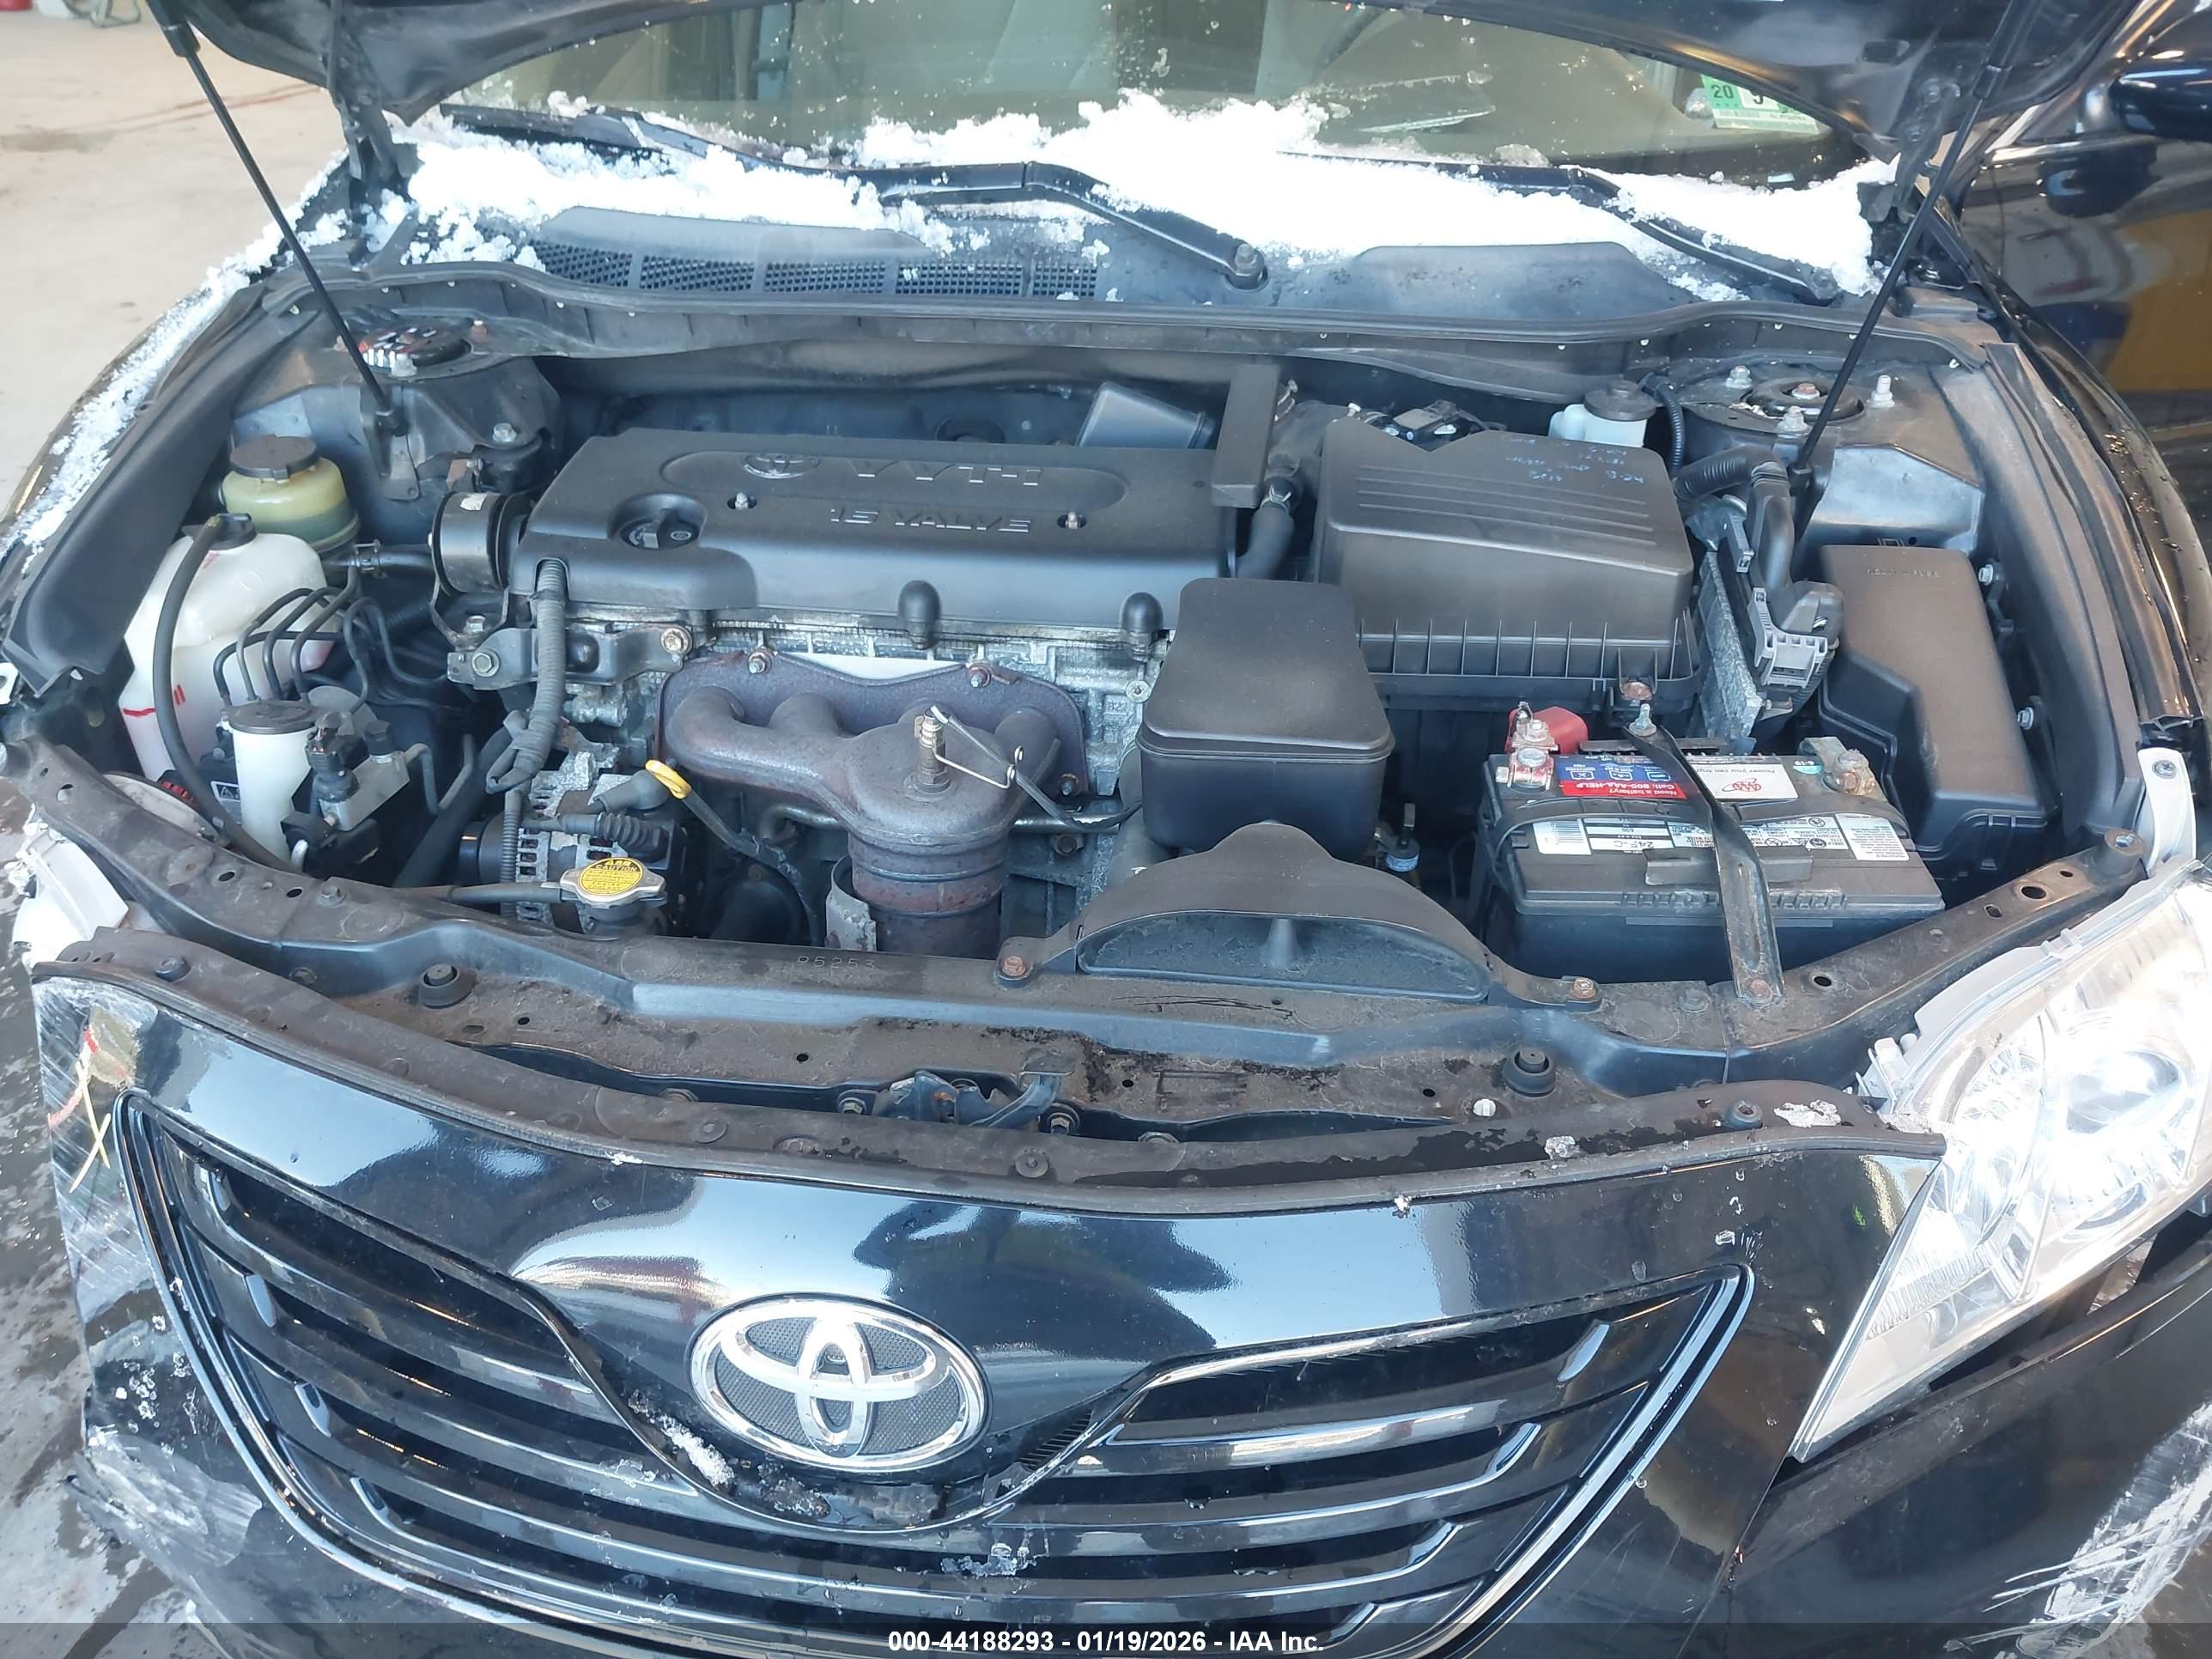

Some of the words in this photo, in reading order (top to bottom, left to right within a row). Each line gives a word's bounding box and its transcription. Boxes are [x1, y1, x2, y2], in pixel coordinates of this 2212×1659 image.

[1711, 84, 1734, 100] 20
[893, 508, 1031, 533] VALVE
[1608, 787, 1644, 796] battery?
[1733, 782, 1760, 792] AAA
[1613, 840, 1655, 848] 24F-C
